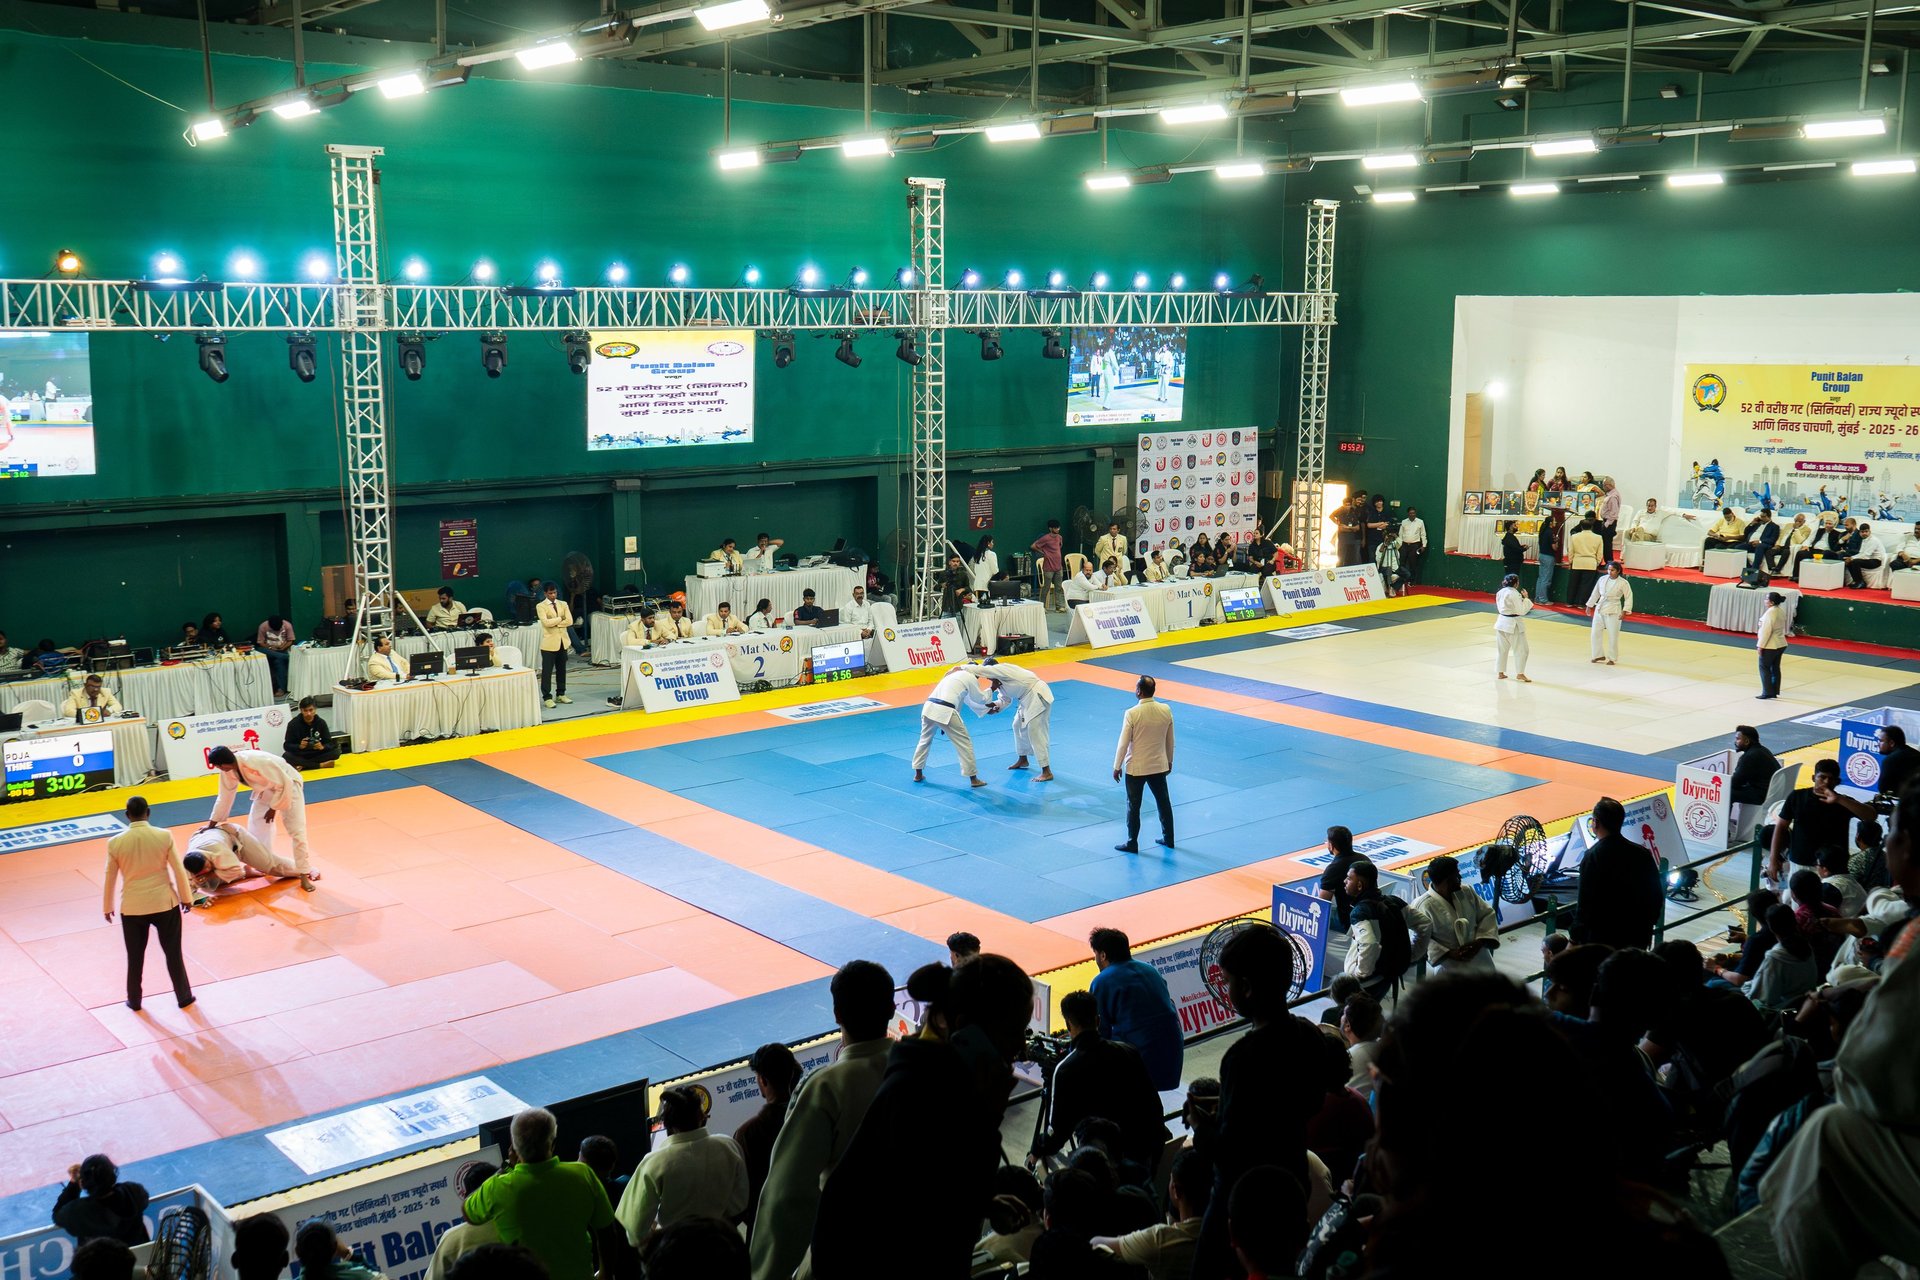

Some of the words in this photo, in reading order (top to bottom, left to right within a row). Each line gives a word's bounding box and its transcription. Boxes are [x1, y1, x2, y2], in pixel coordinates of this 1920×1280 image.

[1811, 372, 1834, 381] Punit
[1836, 372, 1863, 382] Balan
[1822, 382, 1850, 393] Group
[1741, 403, 1752, 413] 52
[1755, 401, 1764, 413] वी
[1790, 405, 1804, 414] गट
[1806, 402, 1855, 418] (सिनियर्स)
[1859, 406, 1882, 416] राज्य
[1884, 404, 1908, 420] ज्यूदो
[1752, 418, 1775, 430] आणि
[1777, 419, 1801, 432] निवड
[1837, 421, 1860, 437] मुंबई
[1869, 424, 1895, 435] 2025
[1906, 425, 1919, 435] 26
[1177, 590, 1190, 599] Mat
[1282, 588, 1301, 600] Punit
[1301, 586, 1321, 598] Balan
[1344, 584, 1370, 602] Oxyrich
[1187, 600, 1193, 618] 1
[1295, 599, 1316, 610] Group
[1095, 618, 1118, 630] Punit
[1117, 615, 1141, 627] Balan
[1110, 629, 1136, 640] Group
[740, 645, 759, 655] Mat
[763, 642, 778, 652] No.
[908, 644, 945, 666] Oxyrich
[754, 656, 765, 678] 2
[844, 657, 850, 665] 0
[654, 675, 686, 690] Punit
[686, 672, 719, 686] Balan
[674, 688, 709, 702] Group
[73, 742, 80, 752] 1
[1846, 731, 1880, 753] Oxyric
[72, 755, 84, 767] 0
[46, 774, 86, 793] 3:02
[1683, 778, 1720, 802] Oxyrich
[0, 836, 48, 848] Bal
[1279, 903, 1318, 936] Oxyrich
[1181, 990, 1209, 1003] Manikchan
[1178, 984, 1236, 1033] xyrich
[716, 1086, 725, 1094] 52
[403, 1202, 423, 1214] 2025
[430, 1196, 440, 1206] 26
